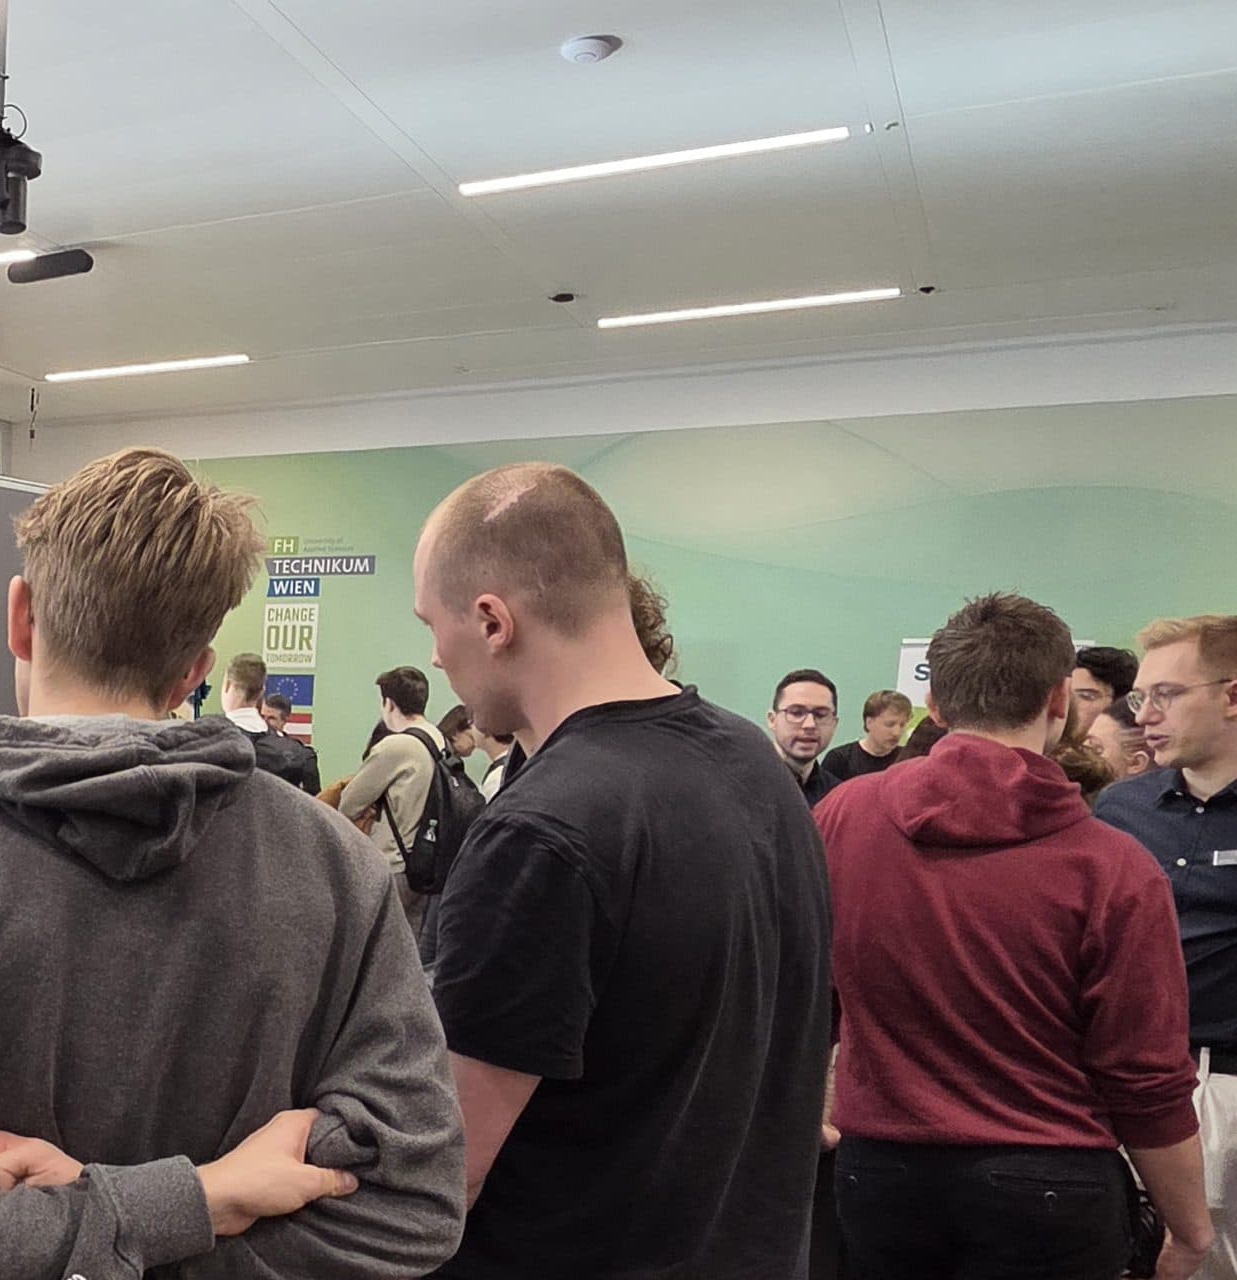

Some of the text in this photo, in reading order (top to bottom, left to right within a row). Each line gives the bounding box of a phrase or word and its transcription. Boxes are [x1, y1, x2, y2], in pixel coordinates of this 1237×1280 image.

[274, 539, 294, 553] FH
[273, 558, 370, 574] TECHNIKUM
[273, 580, 315, 595] WIEN
[267, 607, 315, 622] CHANGE
[266, 624, 313, 651] OUR
[266, 652, 313, 664] TOMORROW
[914, 662, 931, 682] S
